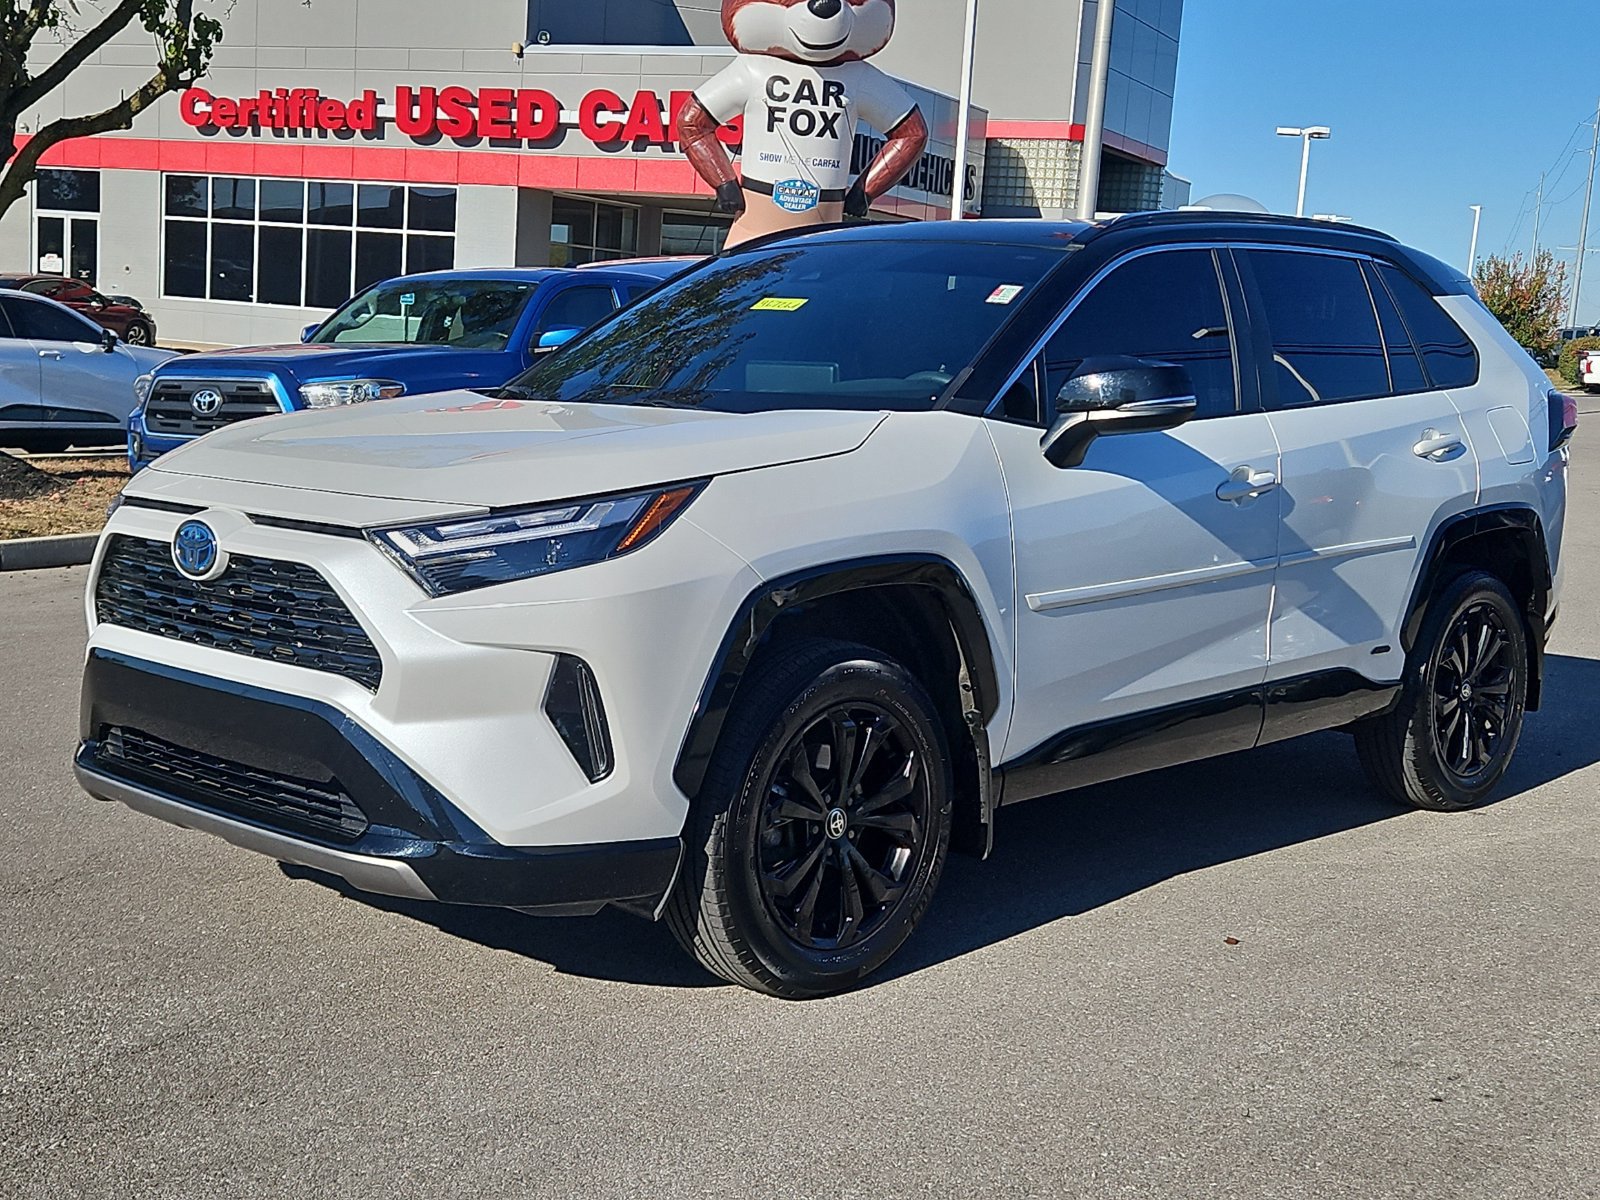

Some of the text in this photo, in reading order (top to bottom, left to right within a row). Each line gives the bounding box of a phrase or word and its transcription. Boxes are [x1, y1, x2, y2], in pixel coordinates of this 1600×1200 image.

[765, 75, 846, 108] CAR
[180, 87, 378, 130] Certified
[396, 86, 560, 138] USED
[767, 105, 842, 140] FOX
[759, 152, 782, 163] SHOW
[812, 158, 841, 169] CARFAX
[906, 154, 977, 201] VEHICS
[783, 202, 807, 210] DEALER
